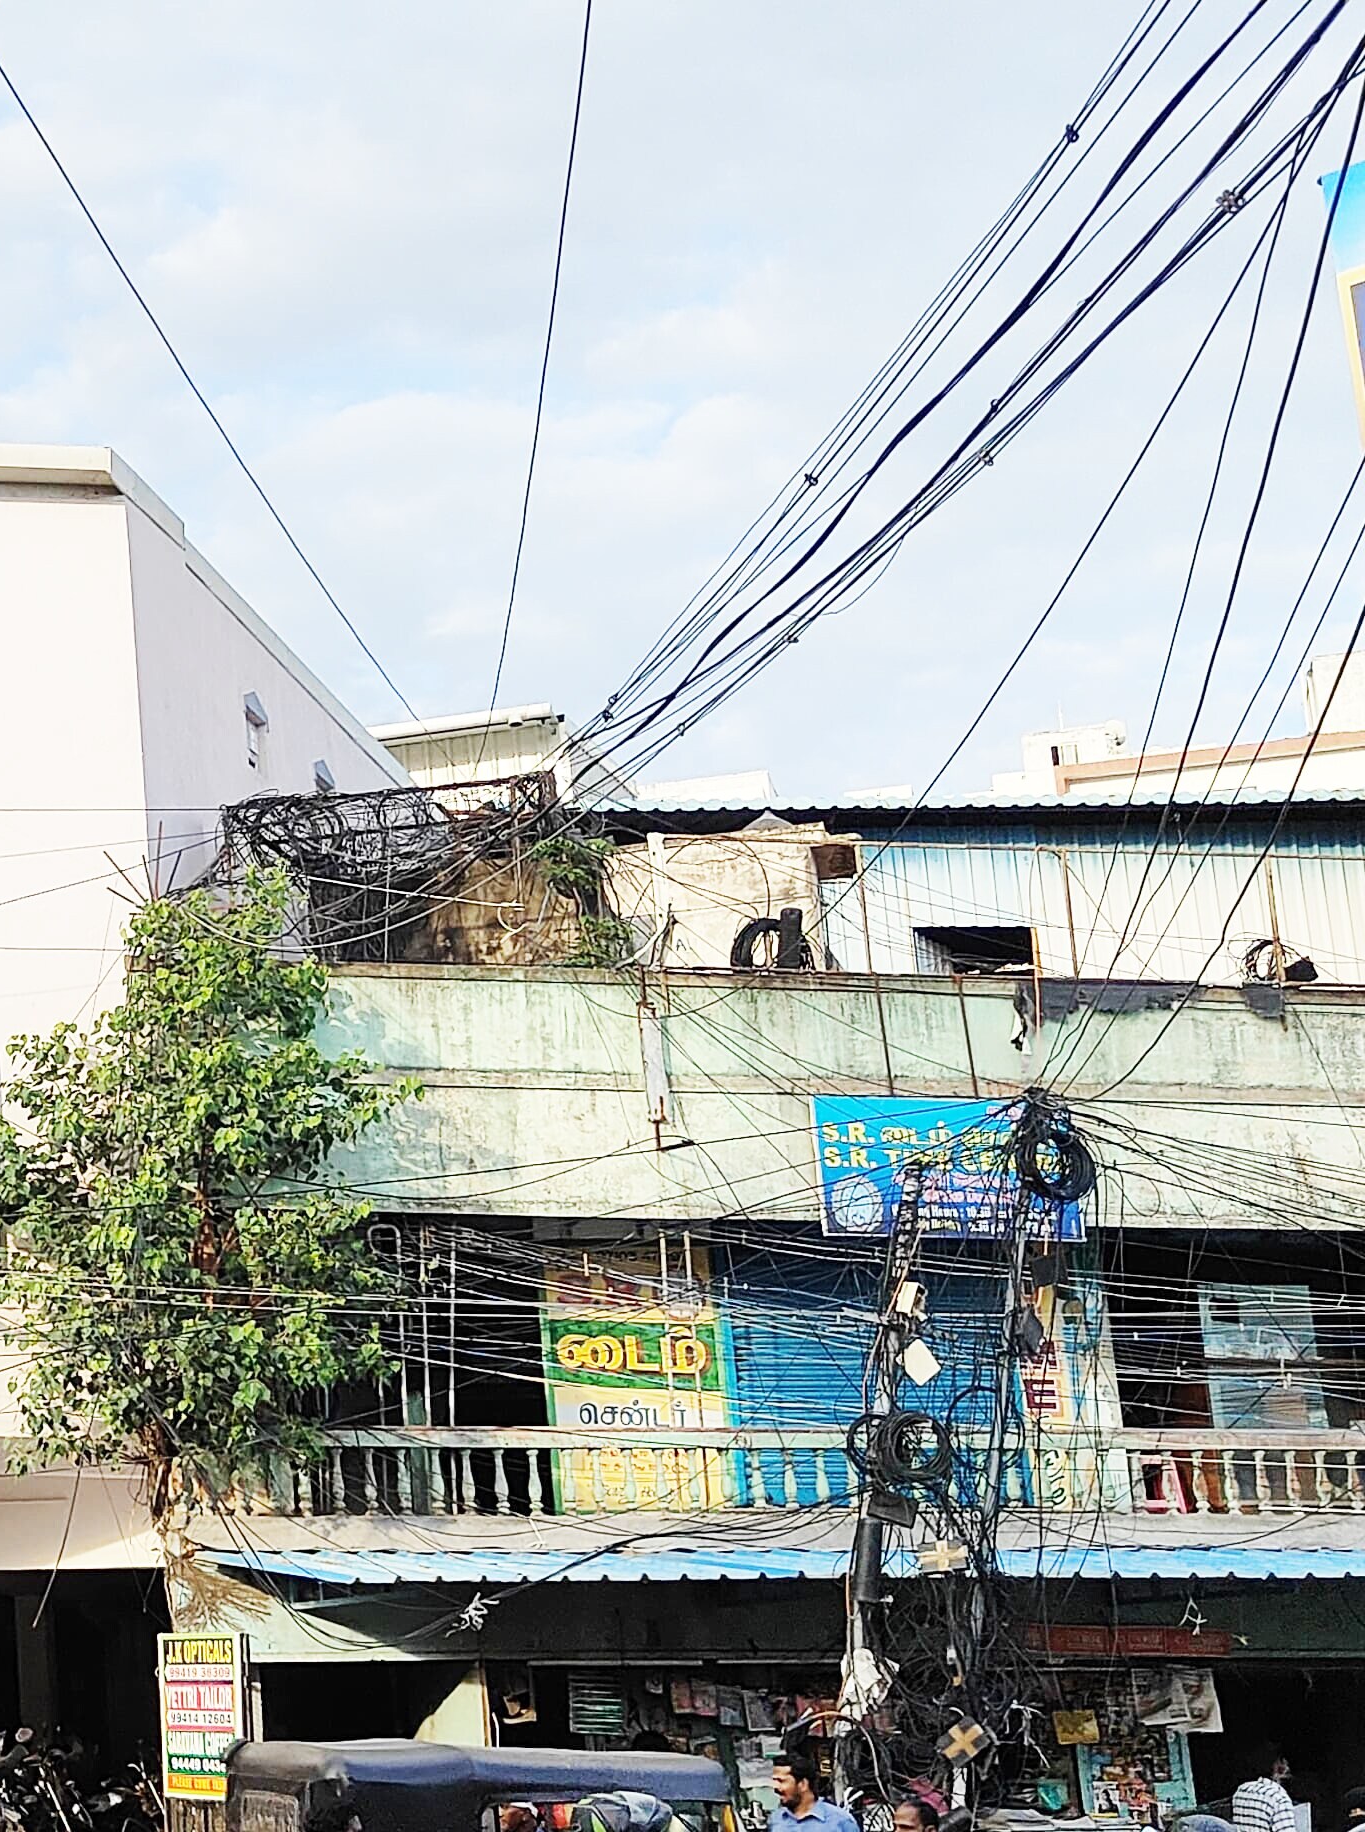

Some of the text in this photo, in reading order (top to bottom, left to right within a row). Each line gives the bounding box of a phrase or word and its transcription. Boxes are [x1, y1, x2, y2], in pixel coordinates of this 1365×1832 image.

[822, 1122, 875, 1144] S.R.
[823, 1147, 878, 1169] S.R.
[183, 1639, 232, 1664] OPTICALS
[165, 1685, 233, 1710] VETTRI TAILOR
[171, 1712, 232, 1724] 99414 12604
